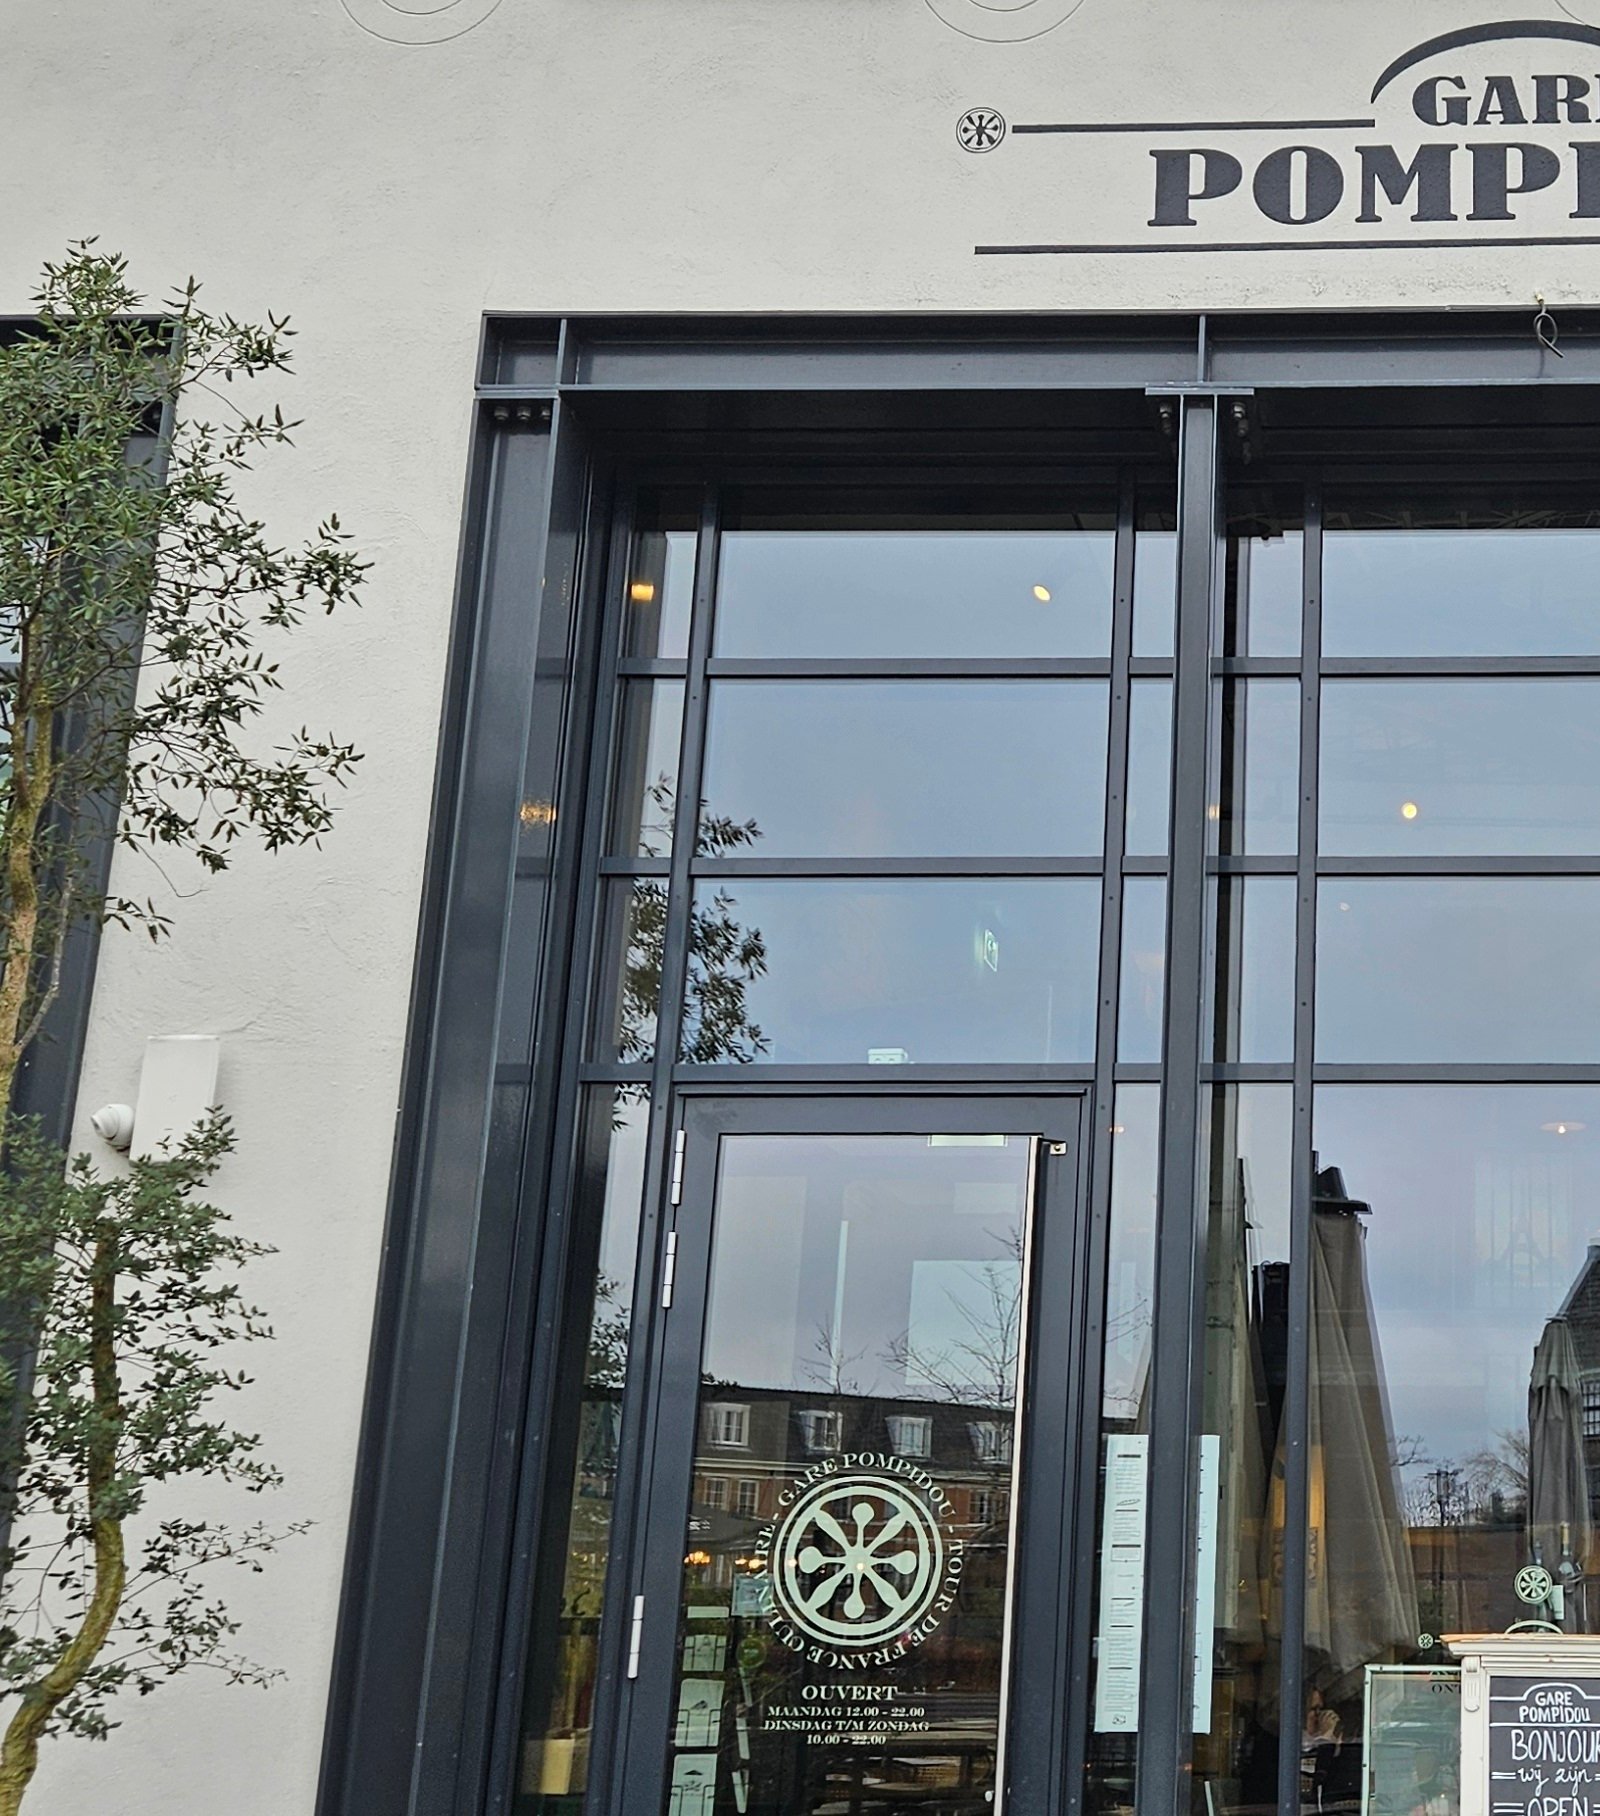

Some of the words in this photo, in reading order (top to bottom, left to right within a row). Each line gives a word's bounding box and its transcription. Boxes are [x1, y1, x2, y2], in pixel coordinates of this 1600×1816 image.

[778, 1458, 838, 1506] GARE
[842, 1452, 956, 1518] POMPIDOU
[935, 1539, 963, 1612] TOUR
[909, 1615, 940, 1647] DE
[806, 1643, 907, 1669] FRANCE
[801, 1685, 898, 1701] OUVERT
[1534, 1691, 1573, 1706] GARE
[767, 1706, 842, 1717] MAANDAG
[846, 1706, 880, 1717] 12.00
[890, 1707, 925, 1717] 22.00
[1518, 1704, 1592, 1723] POMPIDOU
[763, 1720, 832, 1731] DINSDAG
[835, 1719, 864, 1731] T/M
[867, 1720, 930, 1732] ZONDAG
[806, 1734, 840, 1745] 10.00
[851, 1735, 887, 1745] 22.00
